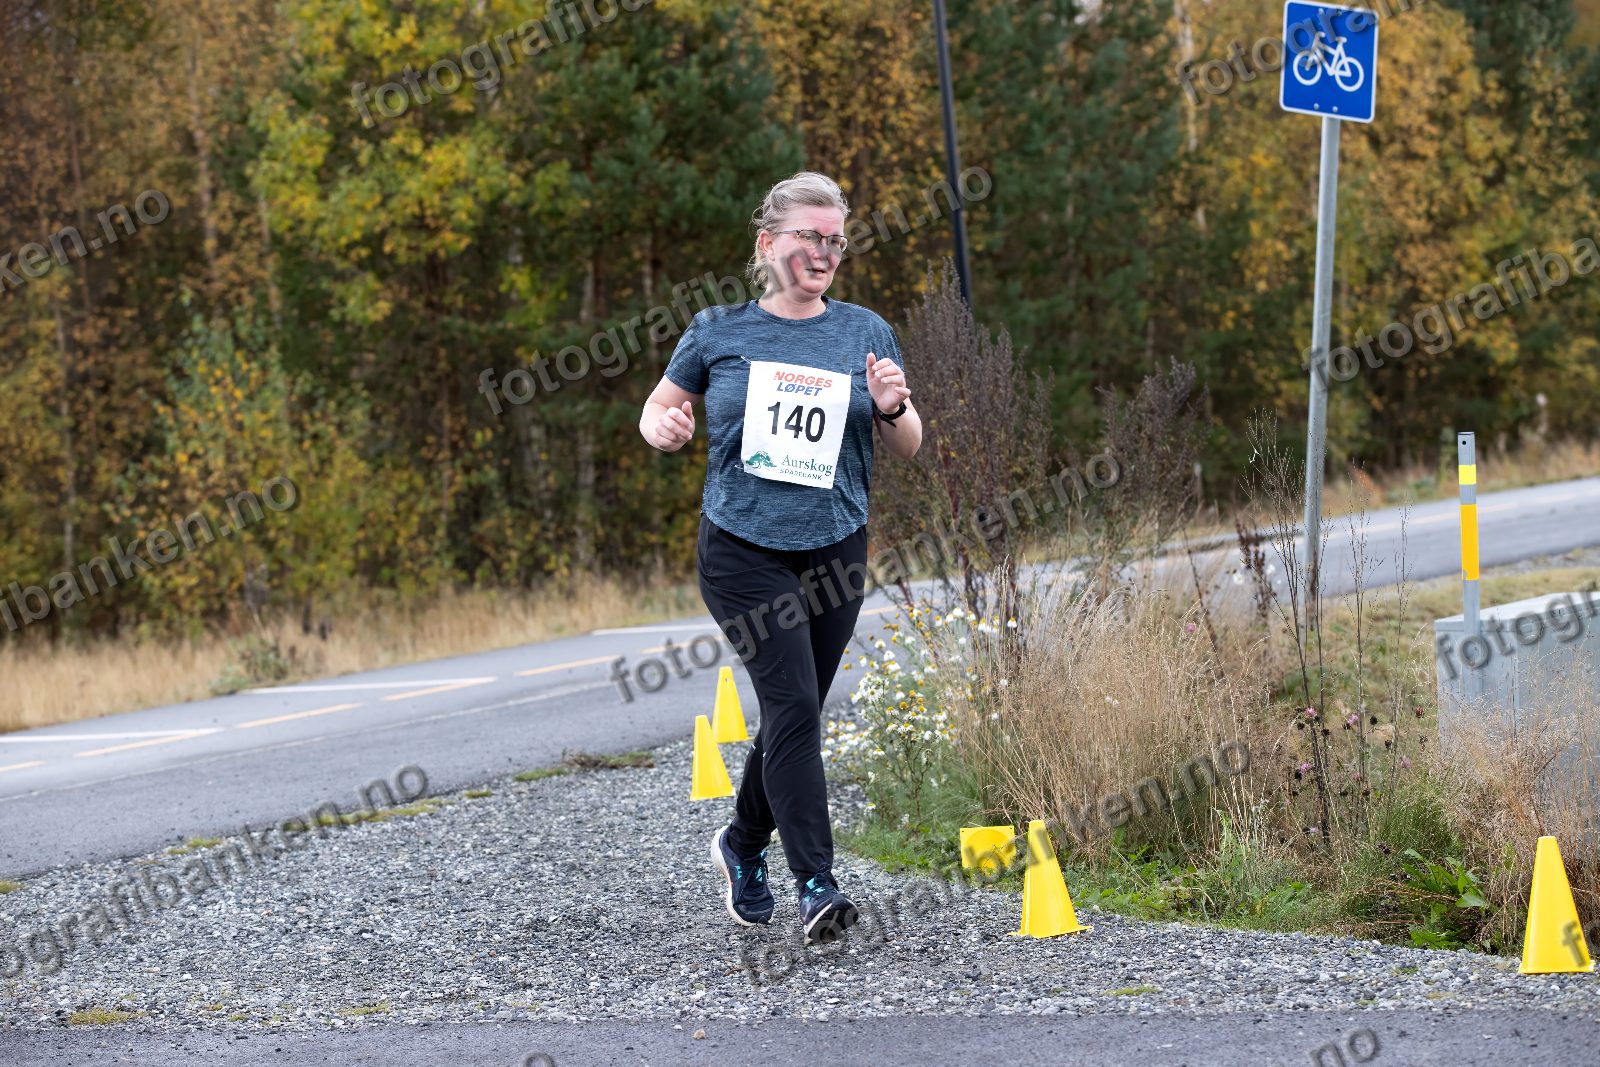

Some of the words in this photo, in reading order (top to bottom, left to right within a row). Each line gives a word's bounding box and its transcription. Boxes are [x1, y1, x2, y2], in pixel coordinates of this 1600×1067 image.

[773, 371, 833, 388] NORGES
[776, 382, 823, 397] LØPET
[767, 401, 826, 443] 140
[781, 454, 833, 476] Aurskog
[779, 468, 823, 481] SPAREBANK
